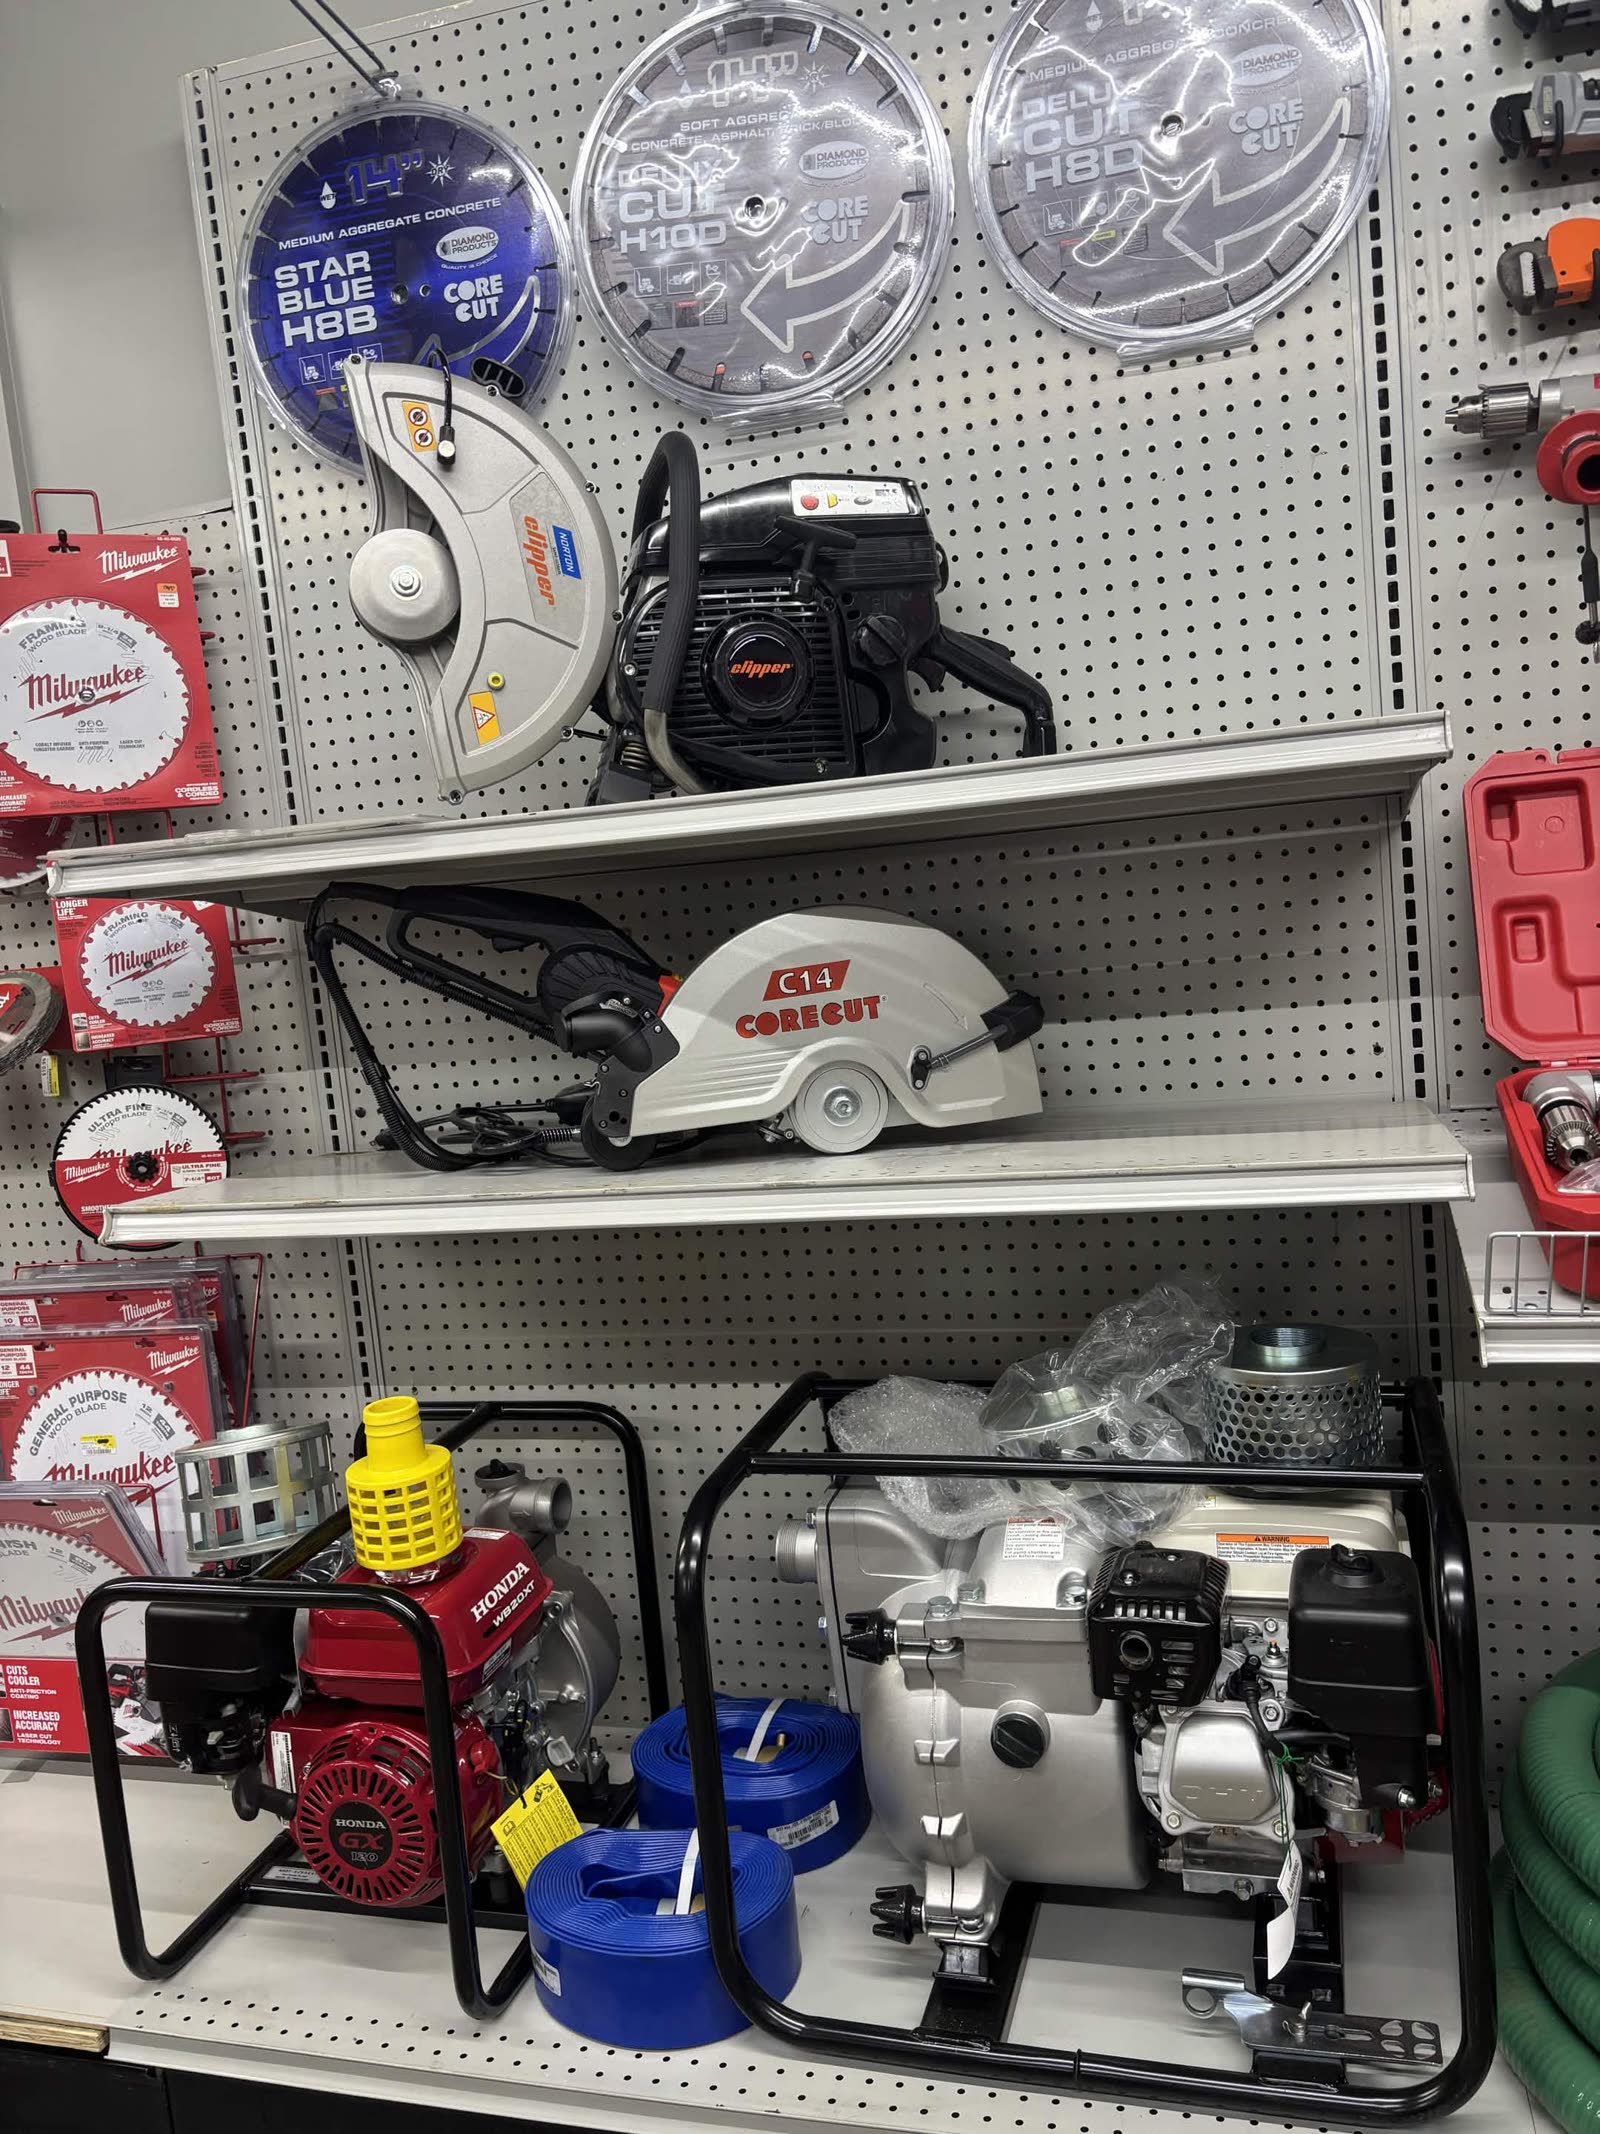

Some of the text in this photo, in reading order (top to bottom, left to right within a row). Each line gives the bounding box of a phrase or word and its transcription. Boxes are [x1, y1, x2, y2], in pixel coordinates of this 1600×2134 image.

[1242, 49, 1299, 69] DIAMOND
[680, 118, 724, 132] SOFT
[1023, 100, 1141, 156] CUT
[1228, 98, 1304, 134] CORE
[711, 127, 776, 144] ASPHALT,
[1241, 123, 1298, 156] CUT
[816, 147, 867, 162] DIAMOND
[816, 158, 867, 170] PRODUCTS
[1025, 139, 1144, 194] H8D
[431, 165, 449, 178] DRY
[320, 191, 337, 202] WET
[618, 182, 726, 224] CUT
[800, 194, 868, 223] CORE
[279, 196, 502, 251] MEDIUM AGGREGATE CONCRETE
[812, 219, 863, 246] CUT
[451, 231, 496, 248] DIAMOND
[452, 240, 497, 254] PRODUCTS
[620, 220, 727, 254] H10D
[274, 250, 372, 289] STAR
[277, 275, 376, 315] BLUE
[443, 273, 504, 304] CORE
[455, 295, 499, 323] CUT
[282, 304, 378, 347] H8B
[96, 544, 178, 575] Milwaukee
[522, 515, 555, 606] clipper
[558, 531, 575, 573] NORTON
[28, 628, 87, 653] WOOD BLADE
[729, 659, 791, 679] clipper
[18, 663, 147, 710] Milwaukee
[174, 784, 219, 794] CORDLESS
[185, 790, 220, 798] CORDED
[55, 899, 89, 909] LONGER
[57, 908, 75, 917] LIFE
[102, 911, 149, 937] FRAMING
[101, 940, 190, 978] Milwaukee
[777, 967, 834, 995] C14
[88, 1103, 152, 1133] ULTRA FINE
[98, 1111, 148, 1132] WOOD BLADE
[63, 1162, 111, 1181] Milwaukee
[119, 1299, 173, 1323] Milwaukee
[146, 1345, 200, 1370] Milwaukee
[29, 1403, 69, 1457] GENERAL
[68, 1389, 128, 1408] PURPOSE
[48, 1402, 107, 1440] WOOD BLADE
[51, 1506, 108, 1525] Milwaukee
[470, 1561, 531, 1623] HONDA
[492, 1579, 535, 1627] WB20XT
[6, 1665, 28, 1675] CUTS
[7, 1675, 41, 1686] COOLER
[12, 1709, 61, 1722] INCREASED
[15, 1720, 59, 1731] ACCURACY
[334, 1818, 387, 1829] HONDA
[338, 1832, 385, 1850] GX
